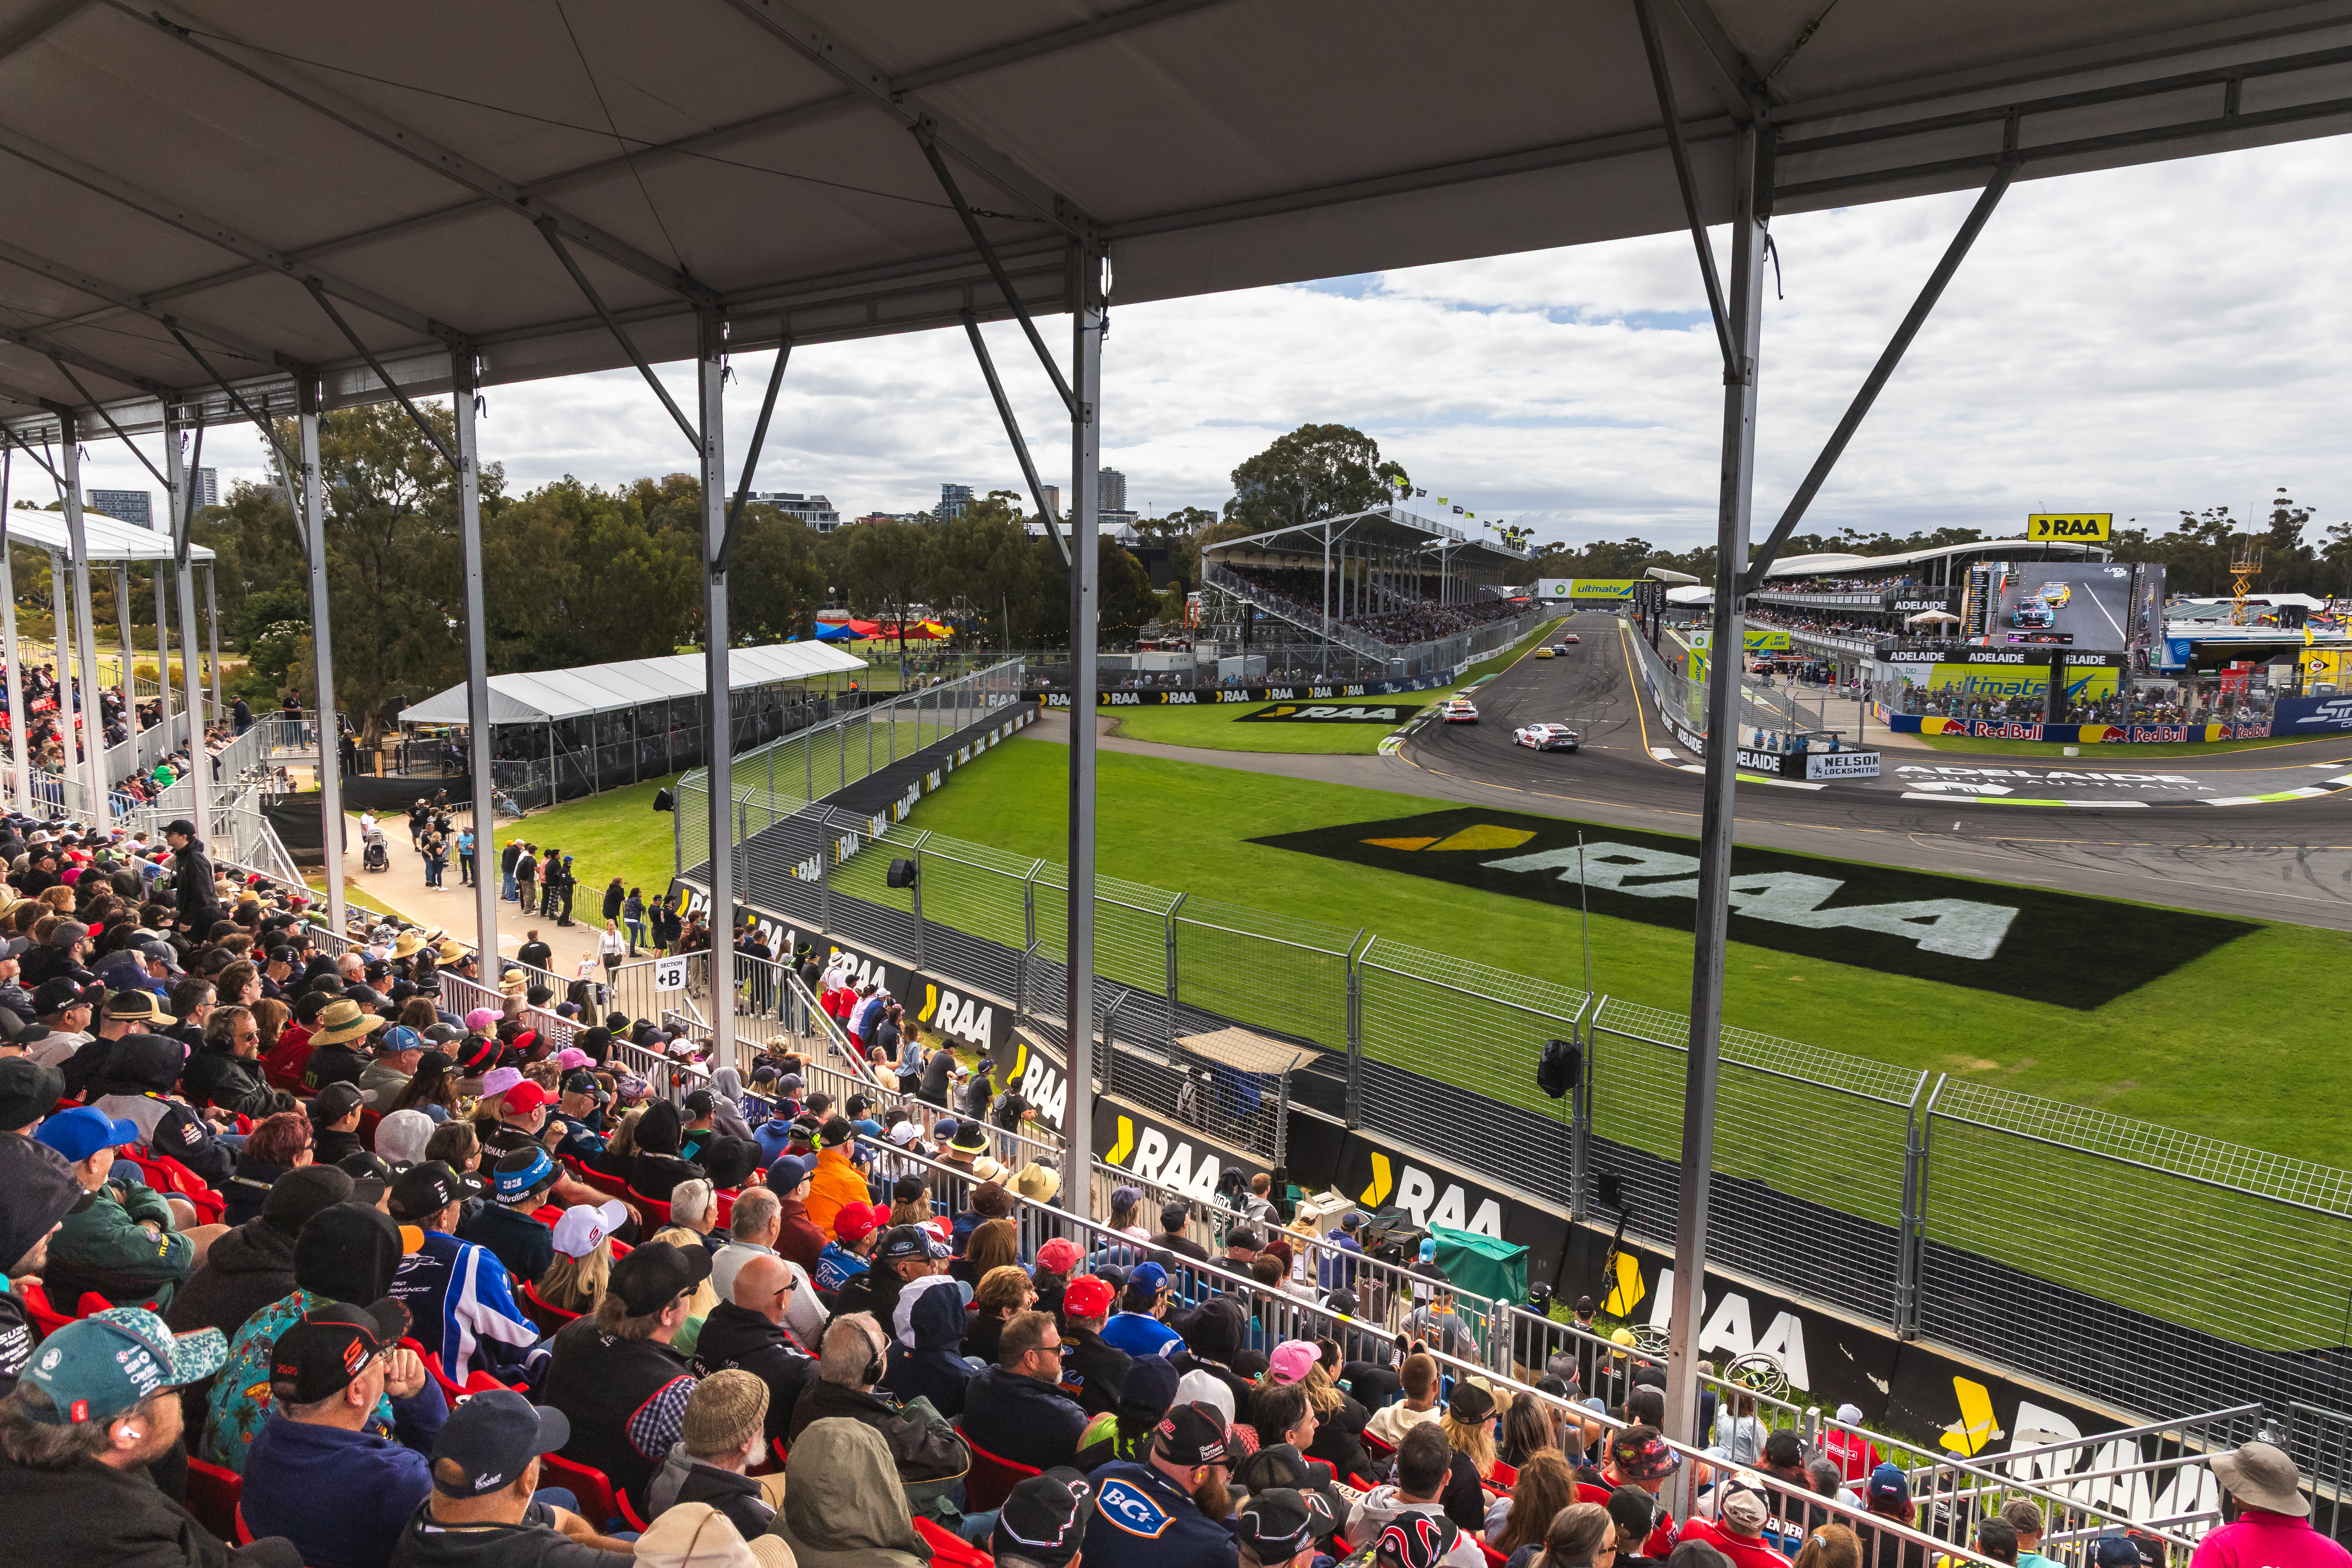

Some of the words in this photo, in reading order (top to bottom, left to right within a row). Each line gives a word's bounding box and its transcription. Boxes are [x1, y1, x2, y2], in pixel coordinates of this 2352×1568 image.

[2053, 519, 2100, 536] RAA
[1578, 584, 1620, 593] ultimate
[1895, 601, 1947, 610] ADELAIDE
[1890, 652, 1945, 661] ADELAIDE
[1969, 653, 2025, 663] ADELAIDE
[1112, 693, 1140, 704] RAA
[1170, 692, 1197, 703] RAA
[1224, 691, 1249, 702] RAA
[1272, 689, 1294, 699] RAA
[1315, 687, 1332, 697] RAA
[1348, 685, 1364, 696] RAA
[989, 694, 1018, 707] RAA
[1292, 707, 1396, 719] RAA
[1662, 710, 1673, 733] ADELAIDE
[1975, 721, 2008, 738] Red
[2009, 723, 2043, 740] Bull
[2134, 727, 2161, 742] Red
[2161, 726, 2188, 742] Bull
[2236, 723, 2254, 739] Red
[2254, 722, 2271, 738] Bull
[977, 736, 985, 755] RAA
[1678, 728, 1702, 754] ADELAIDE
[961, 745, 970, 765] RAA
[1825, 756, 1878, 767] NELSON
[1825, 767, 1878, 775] LOCKSMITHS
[1894, 766, 2199, 783] ADELAIDE
[930, 768, 941, 791] RAA
[2026, 780, 2216, 791] AUSTRALIA
[908, 781, 920, 801] RAA
[897, 794, 910, 822] RAA
[873, 810, 887, 837] RAA
[840, 833, 859, 862] RAA
[1481, 841, 2019, 960] RAA
[668, 970, 680, 986] B
[935, 990, 993, 1049] RAA
[1020, 1054, 1067, 1129] RAA
[1132, 1127, 1220, 1200] RAA
[465, 1178, 482, 1189] 6
[496, 1190, 529, 1203] Valvoline
[1396, 1165, 1502, 1240] RAA
[816, 1263, 845, 1291] Ford
[1199, 1443, 1214, 1453] Shaw
[1201, 1445, 1223, 1458] Partners
[2005, 1401, 2224, 1541] RAA
